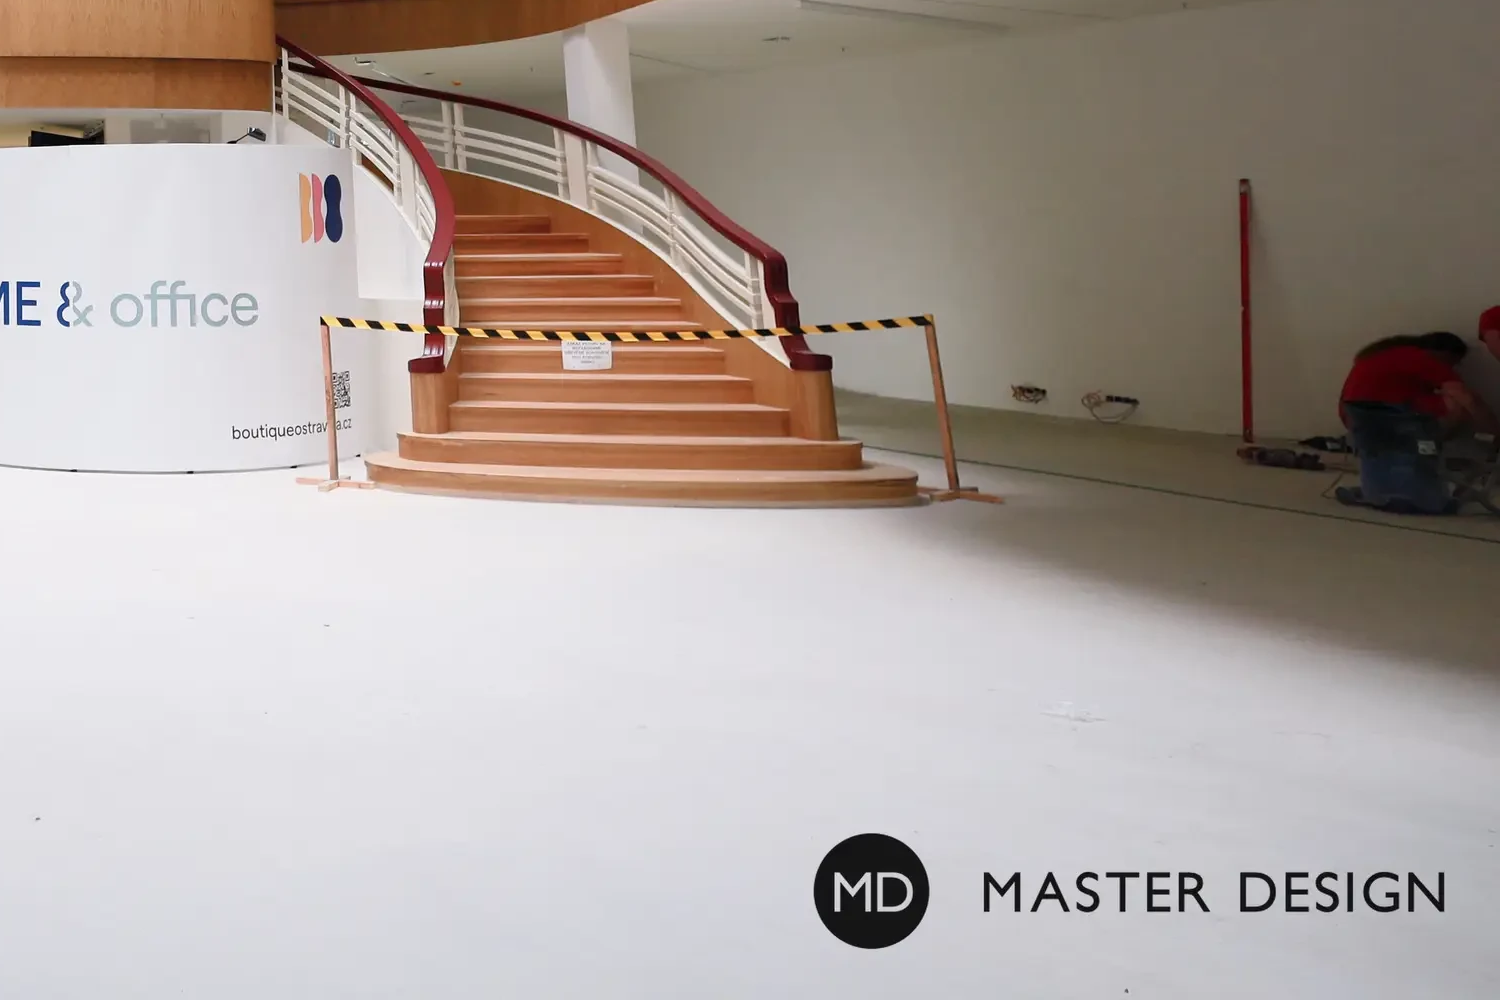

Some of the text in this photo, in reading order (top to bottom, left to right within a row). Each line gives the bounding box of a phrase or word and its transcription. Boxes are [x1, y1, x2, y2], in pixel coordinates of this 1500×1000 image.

[56, 280, 94, 328] &
[109, 279, 259, 328] office
[232, 418, 352, 441] boutiqueostrava.cz
